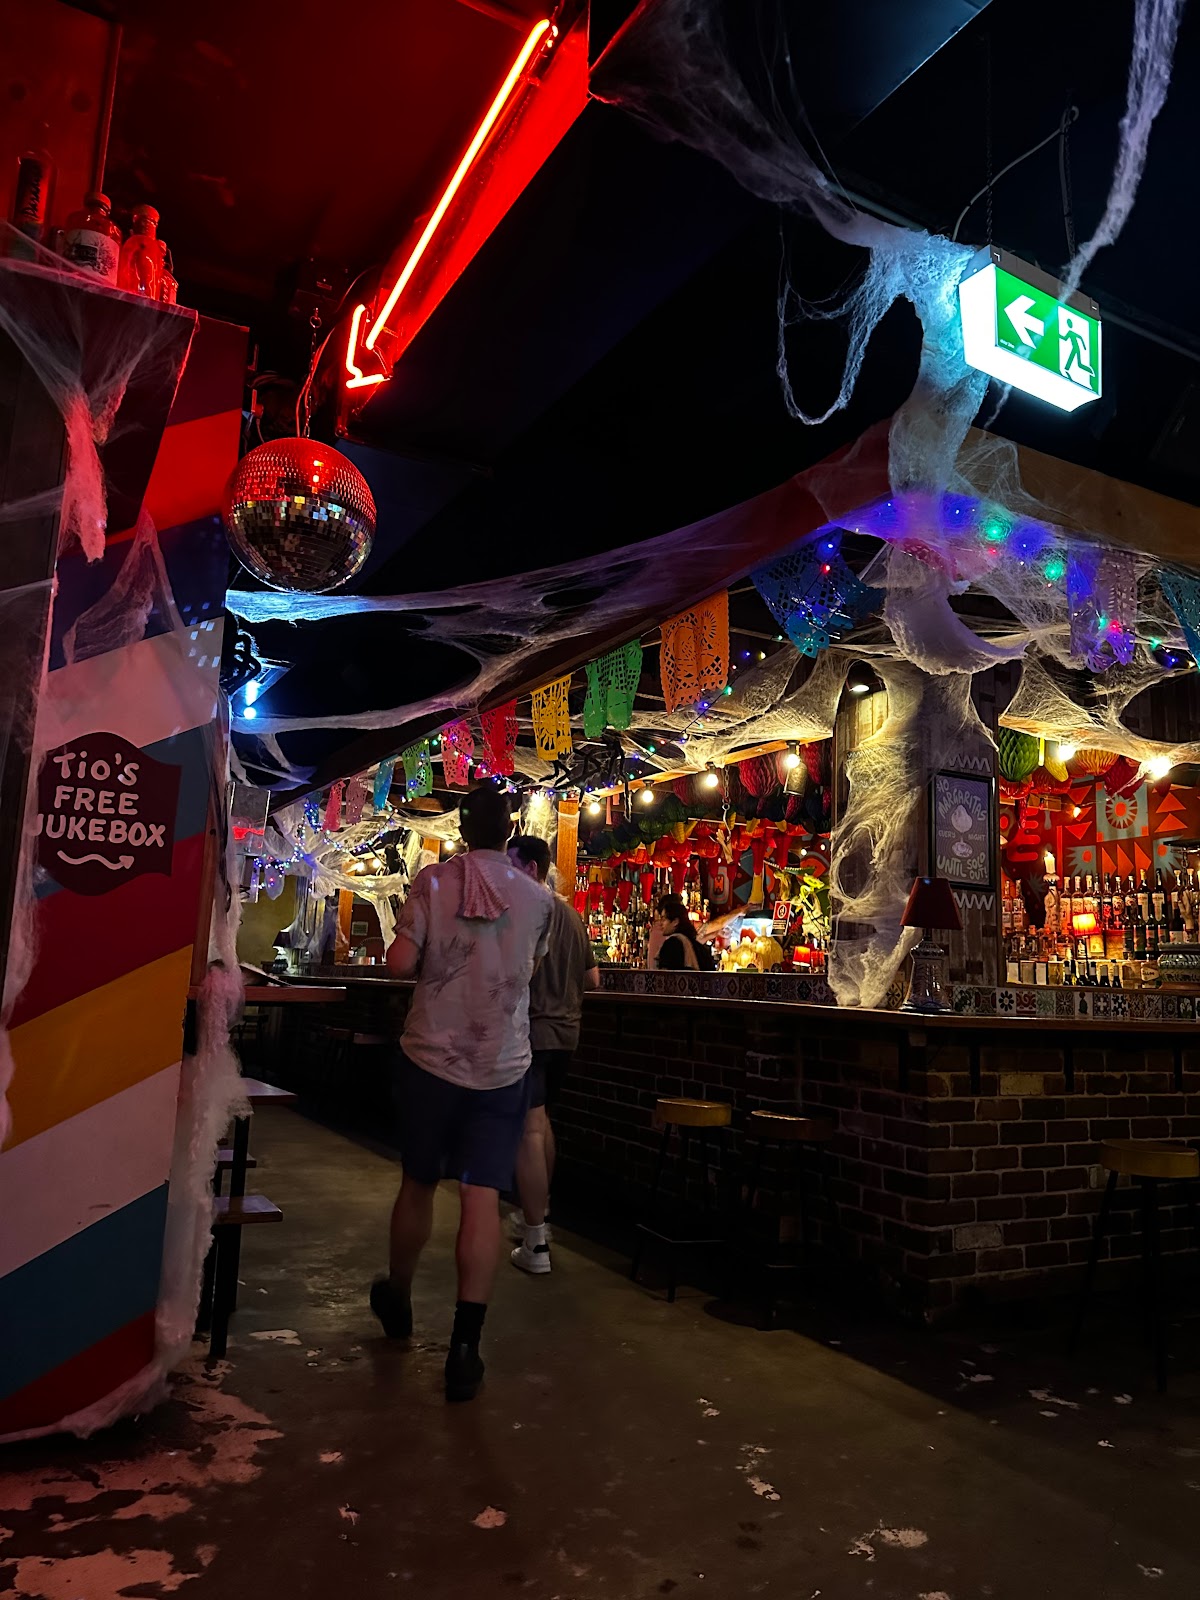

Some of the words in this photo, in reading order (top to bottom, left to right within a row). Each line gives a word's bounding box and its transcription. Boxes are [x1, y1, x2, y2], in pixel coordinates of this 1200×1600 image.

[53, 751, 140, 786] Tio's
[54, 785, 139, 815] FREE
[938, 788, 987, 821] MARGARITAS
[28, 813, 166, 848] JUKEBOX
[938, 830, 956, 838] EVERY
[968, 833, 986, 842] NIGHT
[937, 854, 967, 878] UNTIL
[966, 852, 986, 870] SOLD
[969, 866, 988, 880] OUT!
